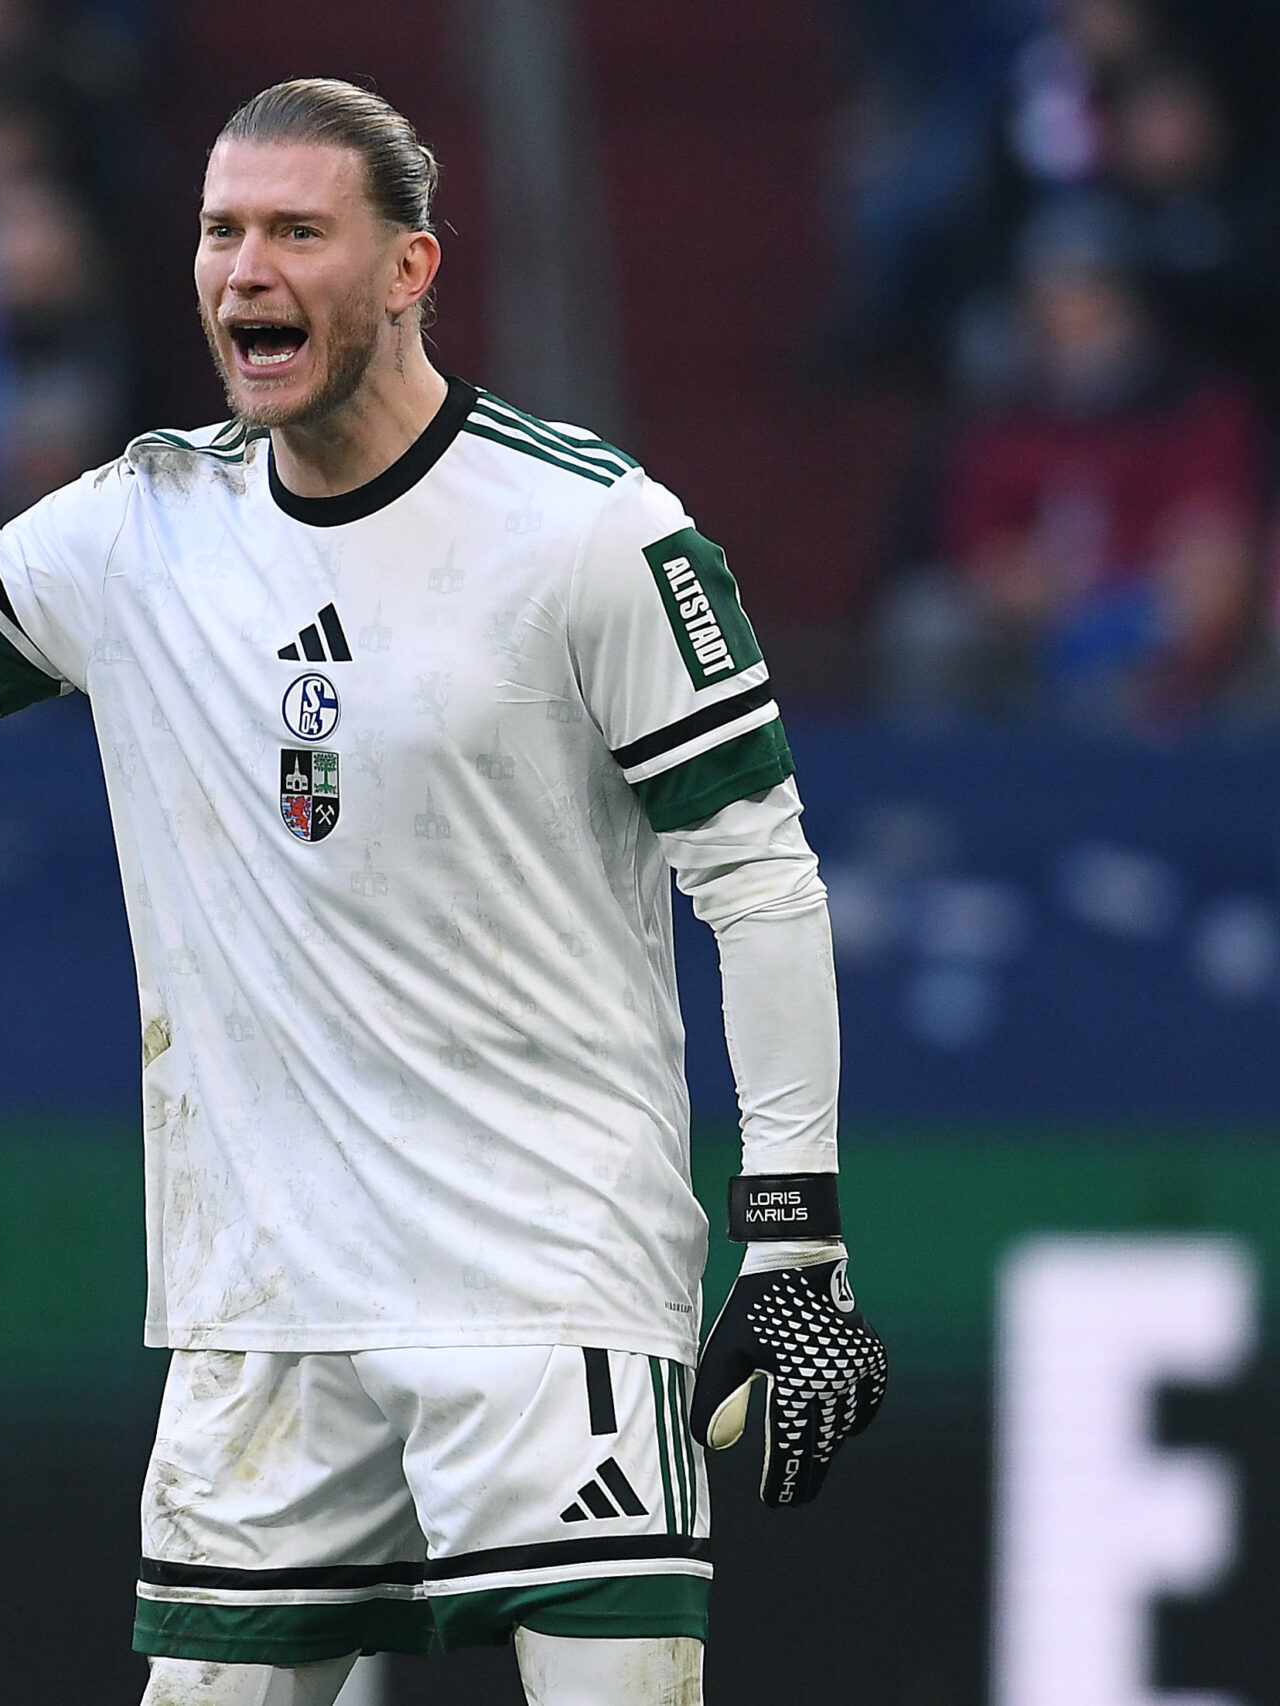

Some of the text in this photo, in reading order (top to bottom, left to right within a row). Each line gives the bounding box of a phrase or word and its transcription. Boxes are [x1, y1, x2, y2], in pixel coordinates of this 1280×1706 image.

[662, 556, 735, 677] ALTSTADT
[749, 1191, 801, 1206] LORIS
[746, 1207, 808, 1222] KARIUS
